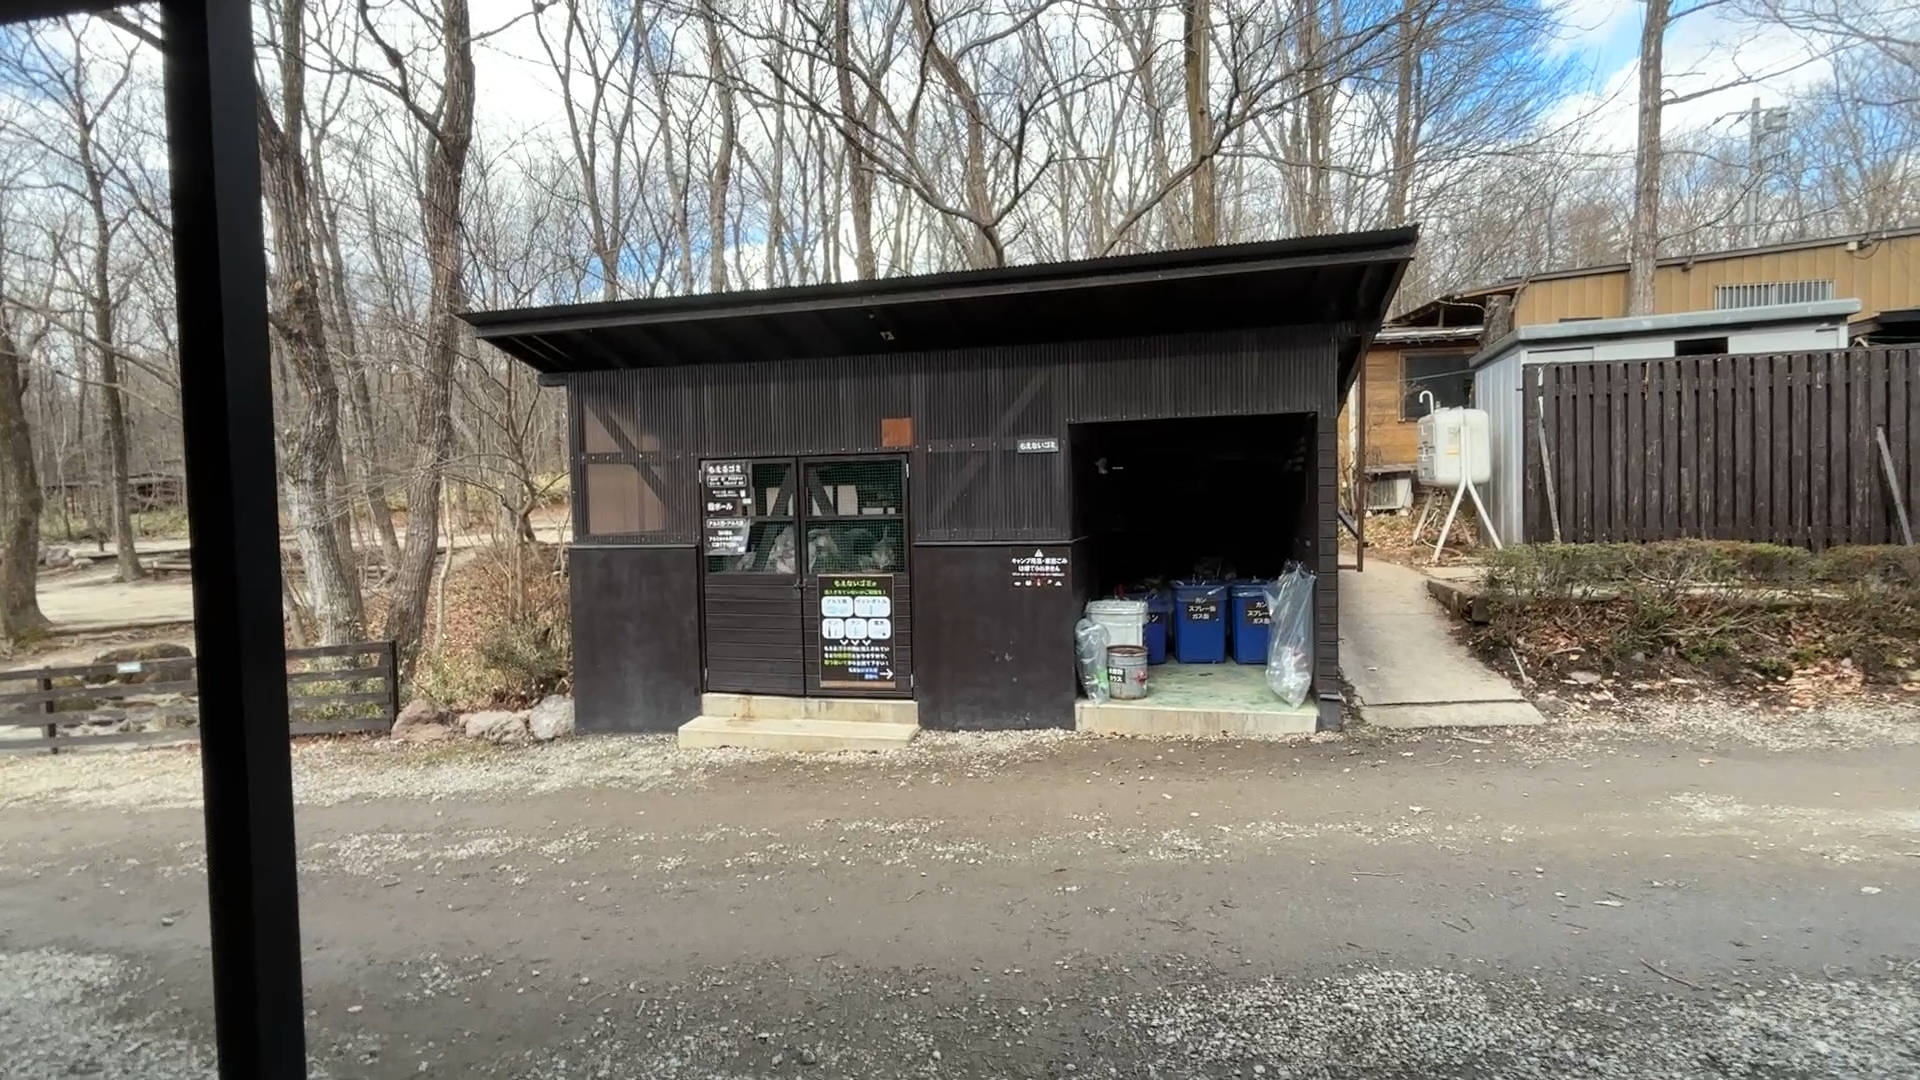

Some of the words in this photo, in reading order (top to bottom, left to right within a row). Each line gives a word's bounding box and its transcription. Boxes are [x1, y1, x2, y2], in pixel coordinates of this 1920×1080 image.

[1020, 442, 1056, 450] もえないゴミ
